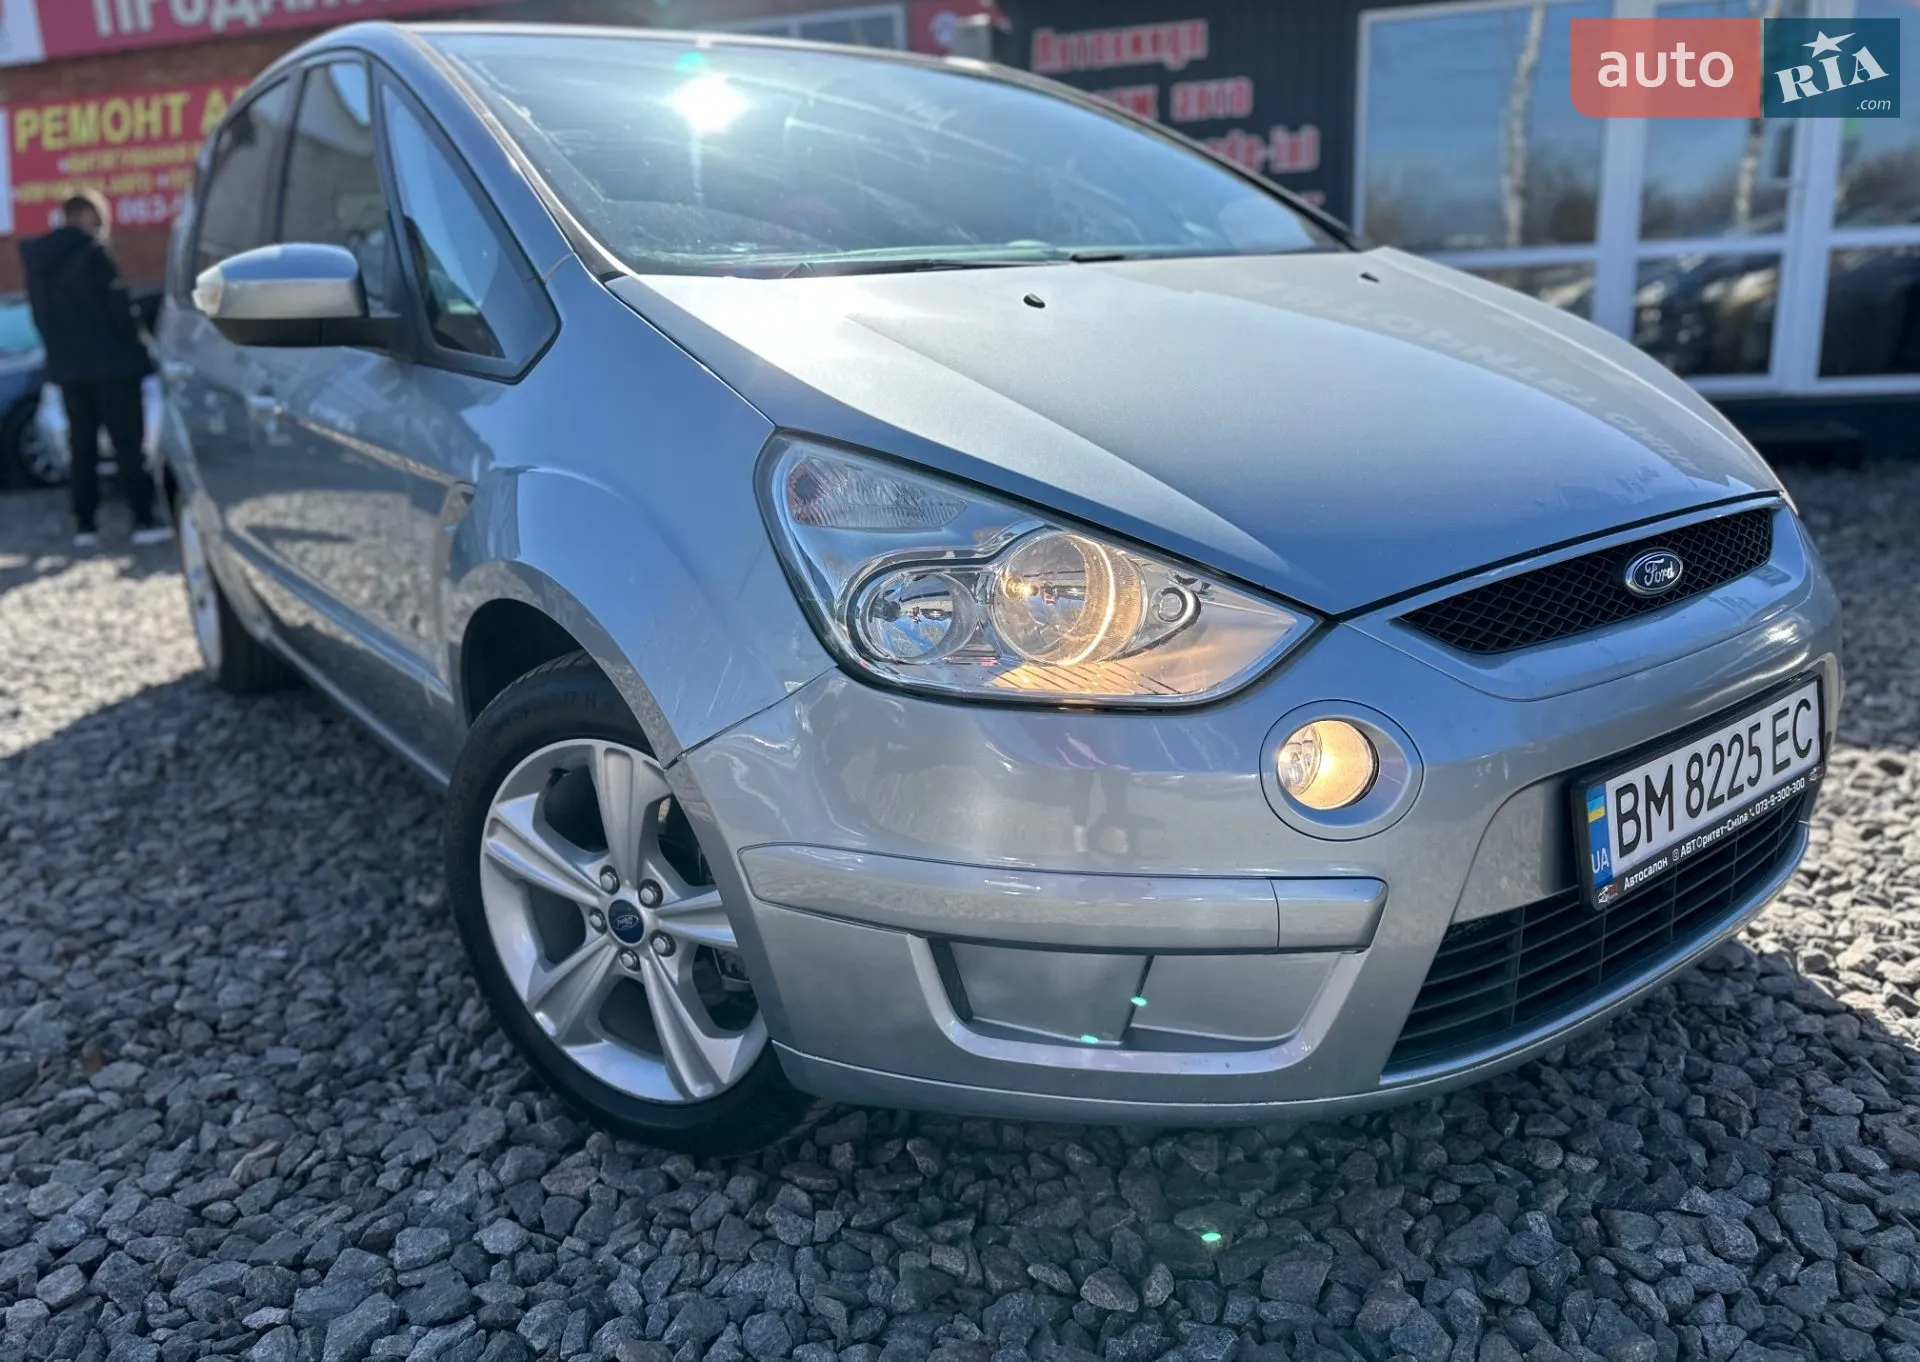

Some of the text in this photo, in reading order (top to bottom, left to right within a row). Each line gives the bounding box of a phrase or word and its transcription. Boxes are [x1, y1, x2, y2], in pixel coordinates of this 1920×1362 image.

[14, 92, 191, 153] РЕМОНТ
[1644, 557, 1675, 587] Ford
[1615, 697, 1813, 858] BM 8225 EC
[1591, 849, 1610, 873] UA
[1624, 856, 1668, 891] Автосалон
[1754, 777, 1805, 815] 073-9-300-300
